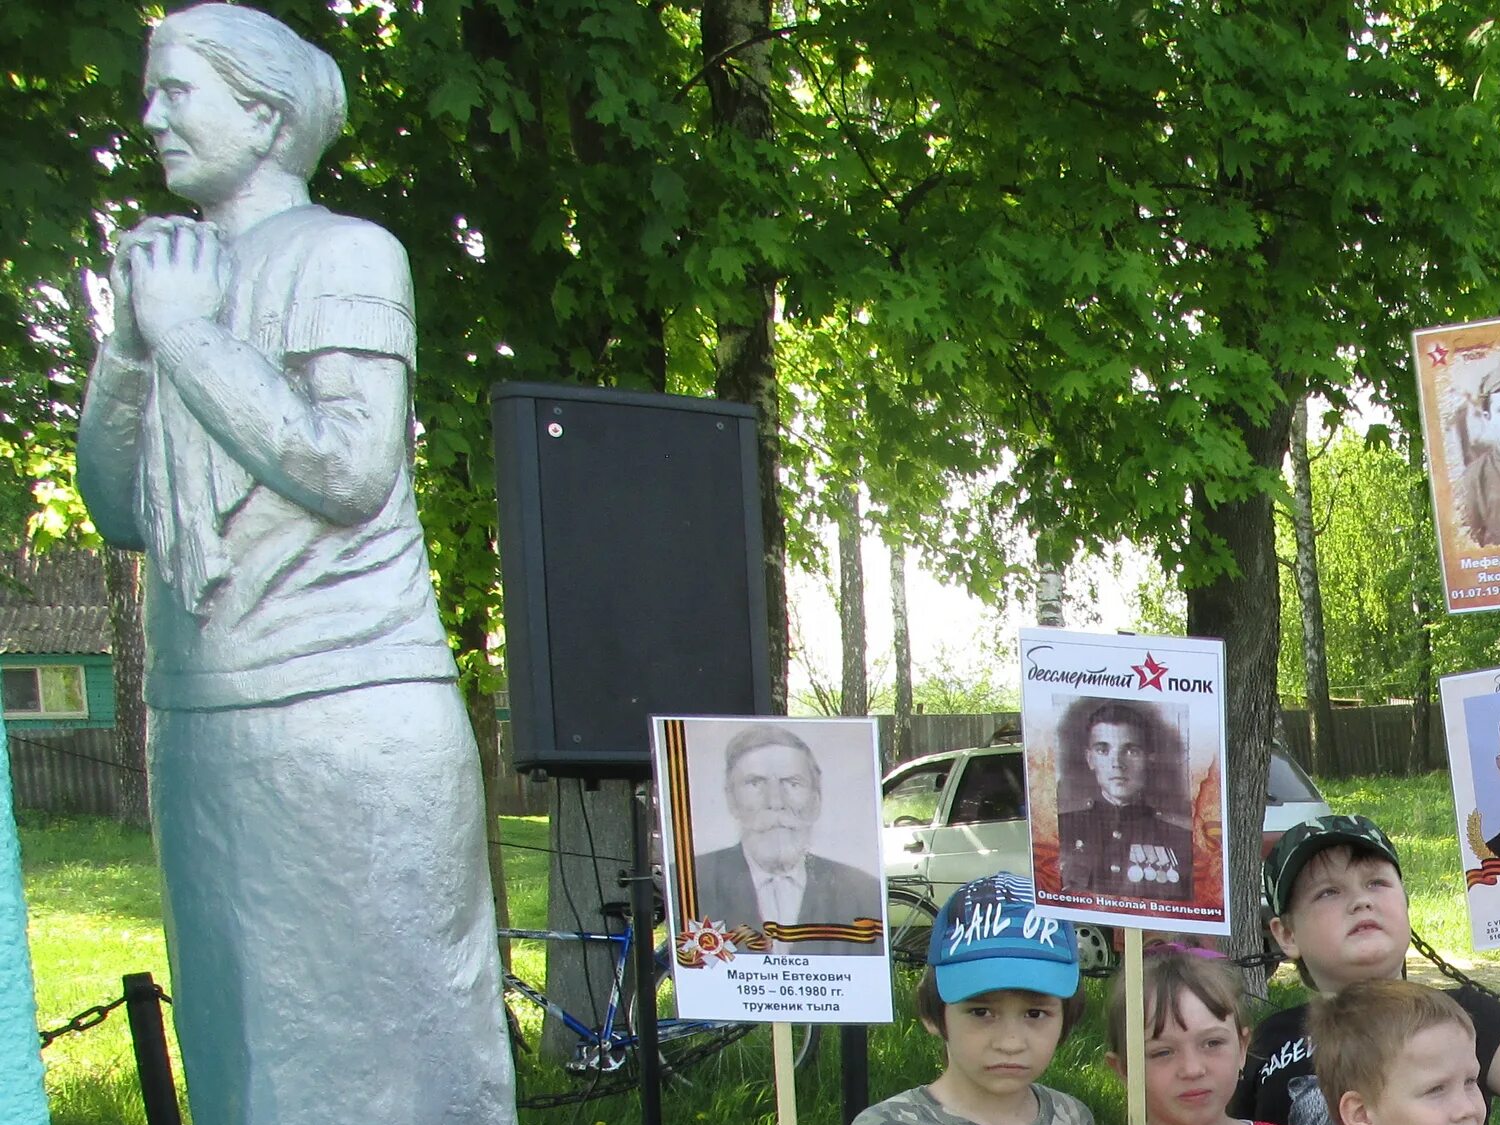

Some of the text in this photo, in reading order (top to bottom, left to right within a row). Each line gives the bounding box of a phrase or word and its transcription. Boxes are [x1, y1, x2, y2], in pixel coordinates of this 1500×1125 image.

[1038, 890, 1222, 916] Овсеенко Николай Васильевич
[763, 955, 809, 966] Алёкса
[727, 970, 851, 983] Мартын Евтехович
[737, 985, 765, 996] 1895
[780, 986, 827, 997] 06.1980
[831, 988, 844, 997] гг.
[743, 1001, 840, 1013] труженик тыла
